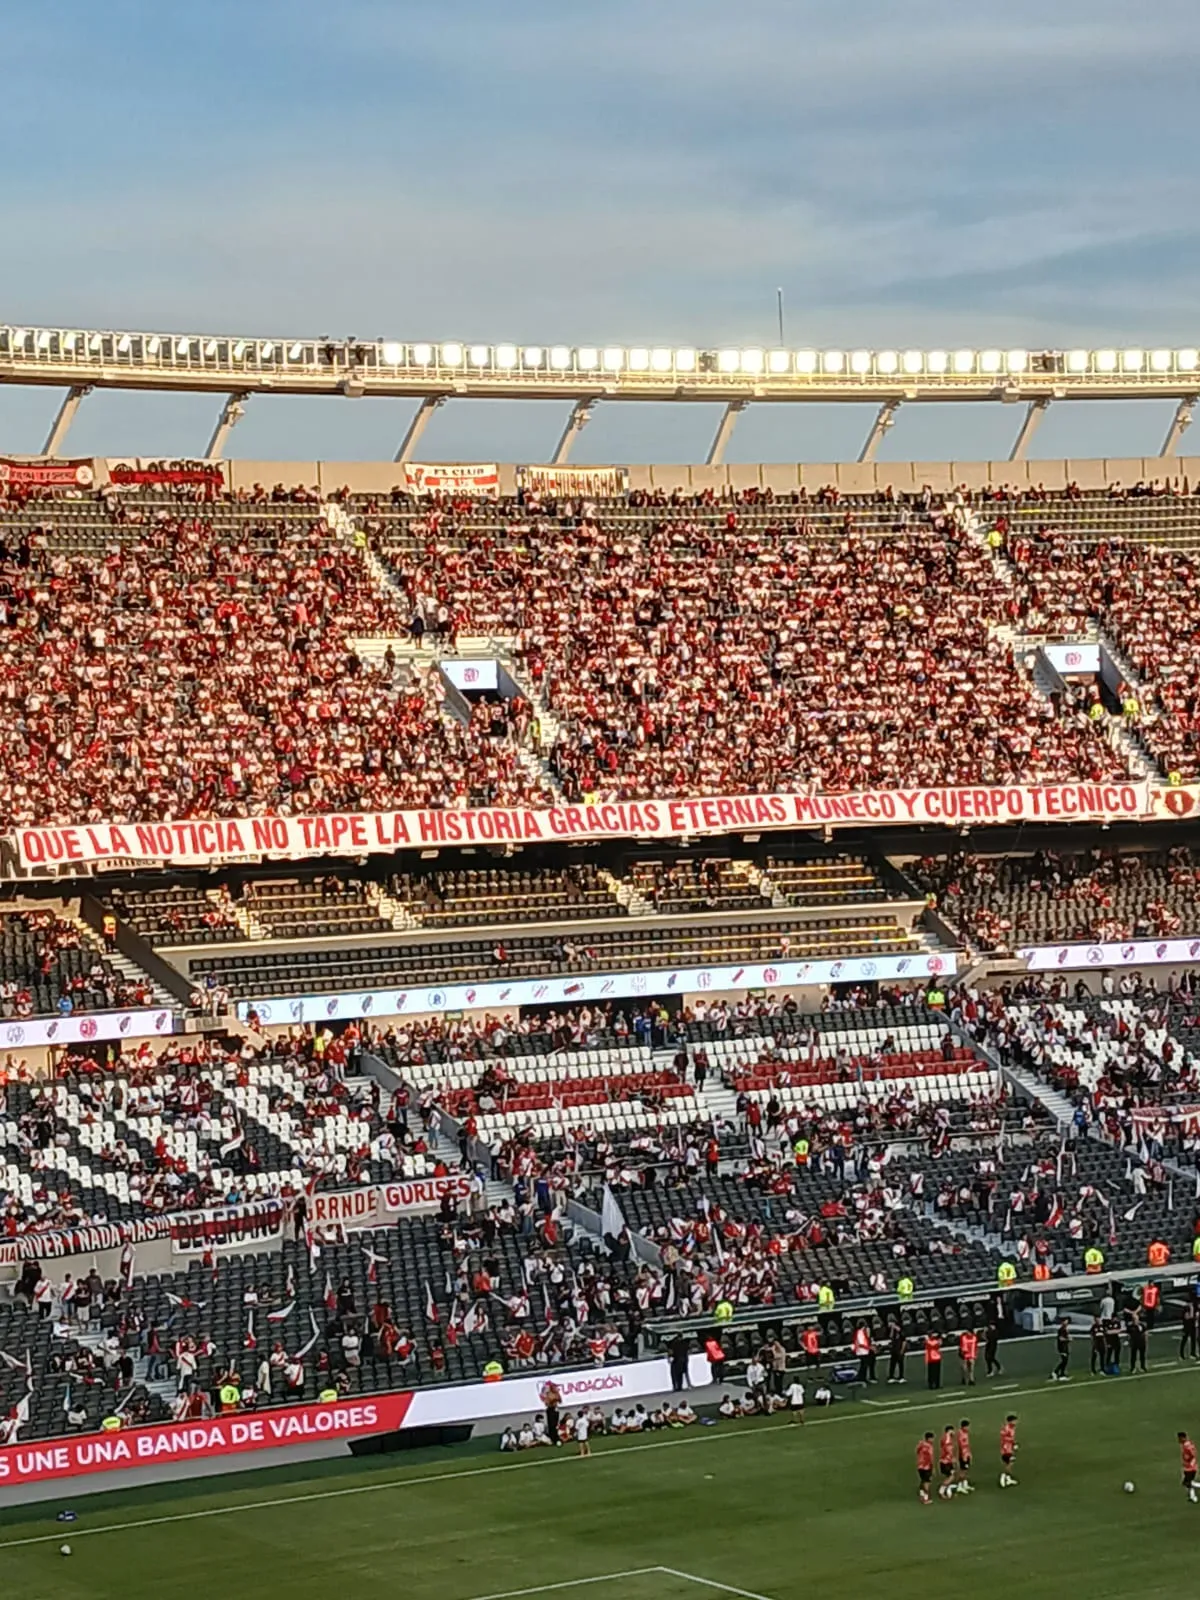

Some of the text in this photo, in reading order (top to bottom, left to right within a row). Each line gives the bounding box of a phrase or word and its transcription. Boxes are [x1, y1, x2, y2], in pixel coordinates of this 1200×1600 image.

[23, 829, 83, 862] QUE
[86, 825, 131, 855] LA
[136, 821, 246, 856] NOTICIA
[252, 817, 290, 850] NO
[297, 815, 368, 848] TAPE
[376, 813, 411, 844] LA
[418, 810, 542, 841] HISTORIA
[549, 803, 661, 835] GRACIAS
[669, 796, 785, 831] ETERNAS
[897, 790, 921, 819] Y
[923, 788, 1024, 819] CUERPO
[1026, 785, 1138, 815] TECNICO
[386, 1177, 471, 1207] GURISES
[16, 1233, 66, 1260] RIVER
[61, 1231, 76, 1255] Y
[76, 1219, 122, 1252] NADA
[175, 1201, 280, 1250] BELGRANO
[557, 1373, 625, 1395] FUNDACIÓN
[16, 1448, 70, 1474] UNE
[76, 1440, 131, 1465] UNA
[137, 1429, 226, 1457] BANDA
[231, 1421, 264, 1444] DE
[268, 1405, 378, 1438] VALORES
